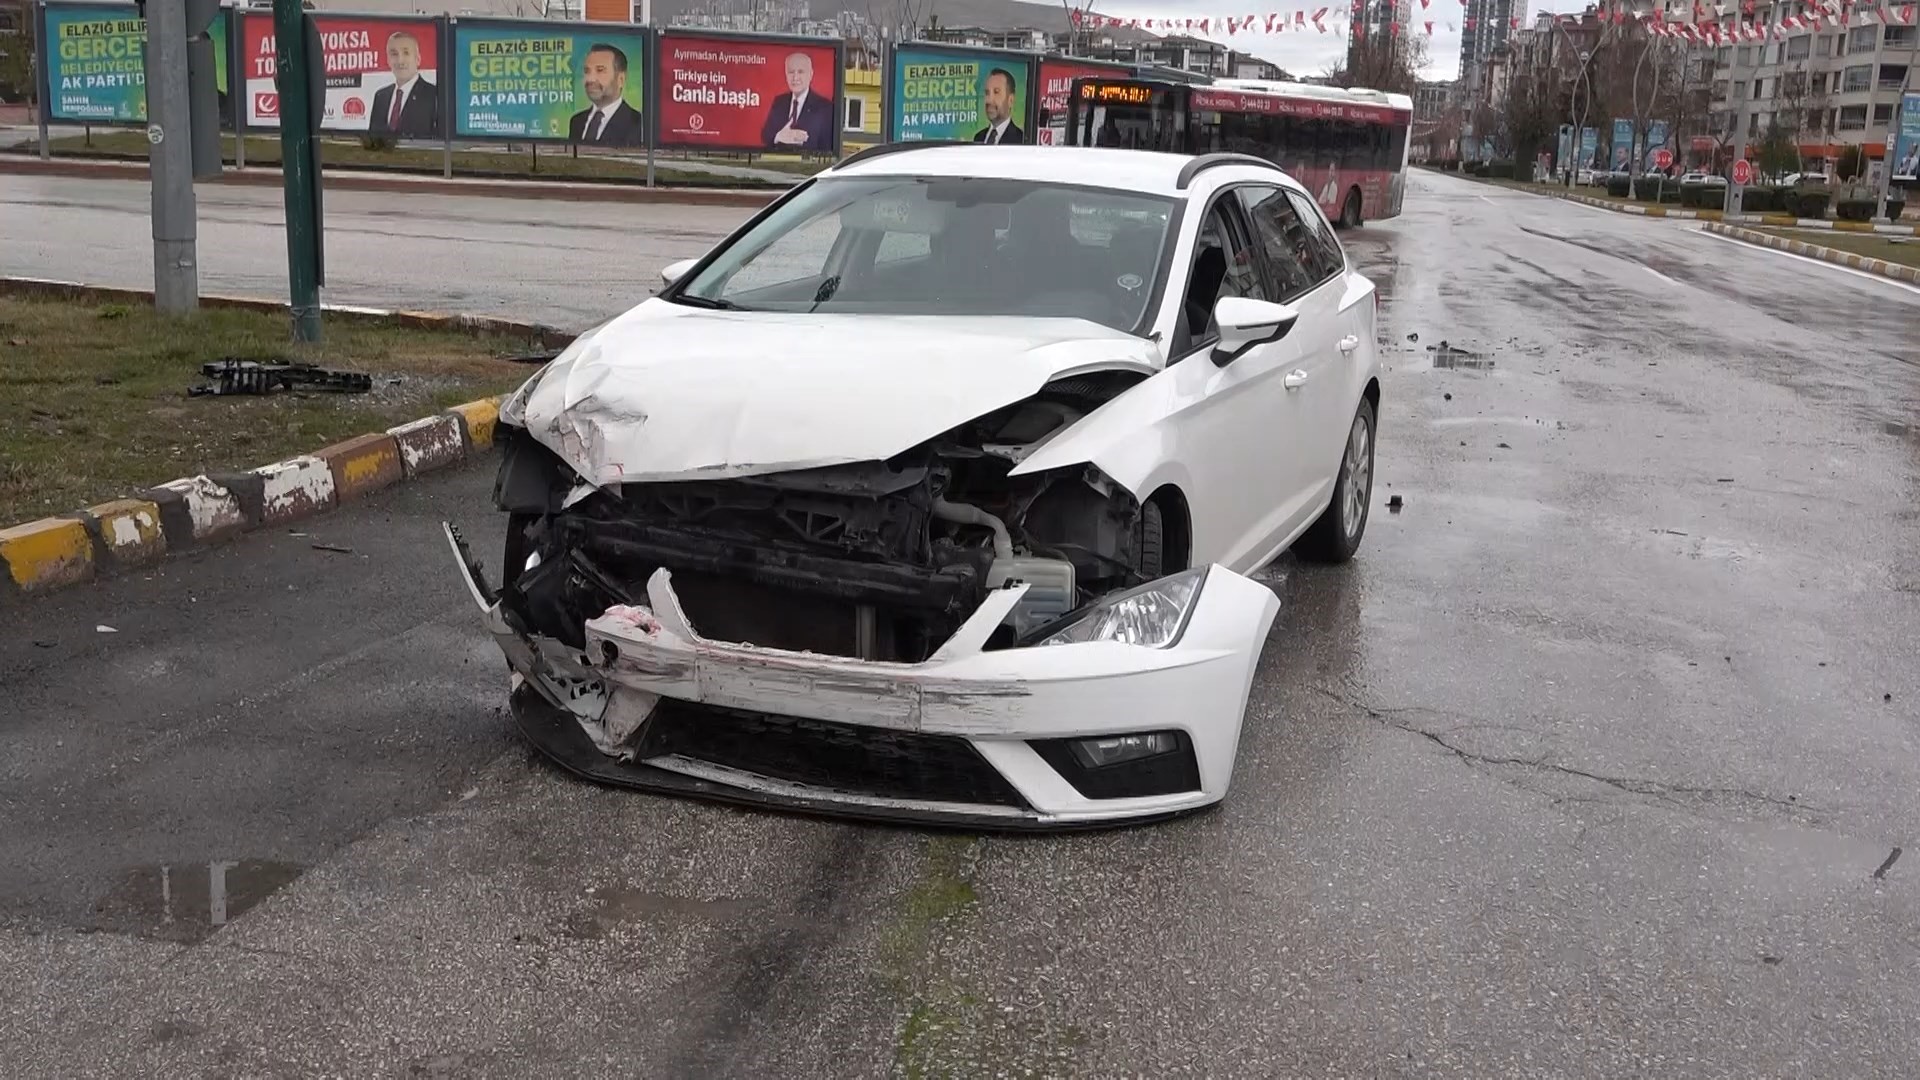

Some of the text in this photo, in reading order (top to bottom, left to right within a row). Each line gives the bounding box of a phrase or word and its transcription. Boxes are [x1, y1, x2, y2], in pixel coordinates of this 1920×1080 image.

[66, 22, 113, 36] ELAZIĞ
[60, 36, 147, 60] GERÇE
[320, 30, 370, 51] YOKSA
[477, 38, 565, 54] ELAZIĞ BİLİR
[673, 48, 767, 65] Ayırmadan Ayrışmadan
[61, 59, 144, 75] BELEDİYECİL
[470, 55, 573, 78] GERÇEK
[909, 63, 973, 78] ELAZIĞ BİLİR
[61, 73, 144, 90] AK PARTİ'D
[470, 77, 573, 93] BELEDİYECİLİK
[673, 68, 727, 85] Türkiye için
[672, 83, 760, 110] Canla başla
[903, 78, 977, 100] GERÇEK
[469, 90, 574, 107] AK PARTİ'DİR
[903, 98, 977, 113] BELEDİYECİLİK
[902, 111, 978, 127] AK PARTİ'DİR
[1734, 168, 1749, 176] DUR
